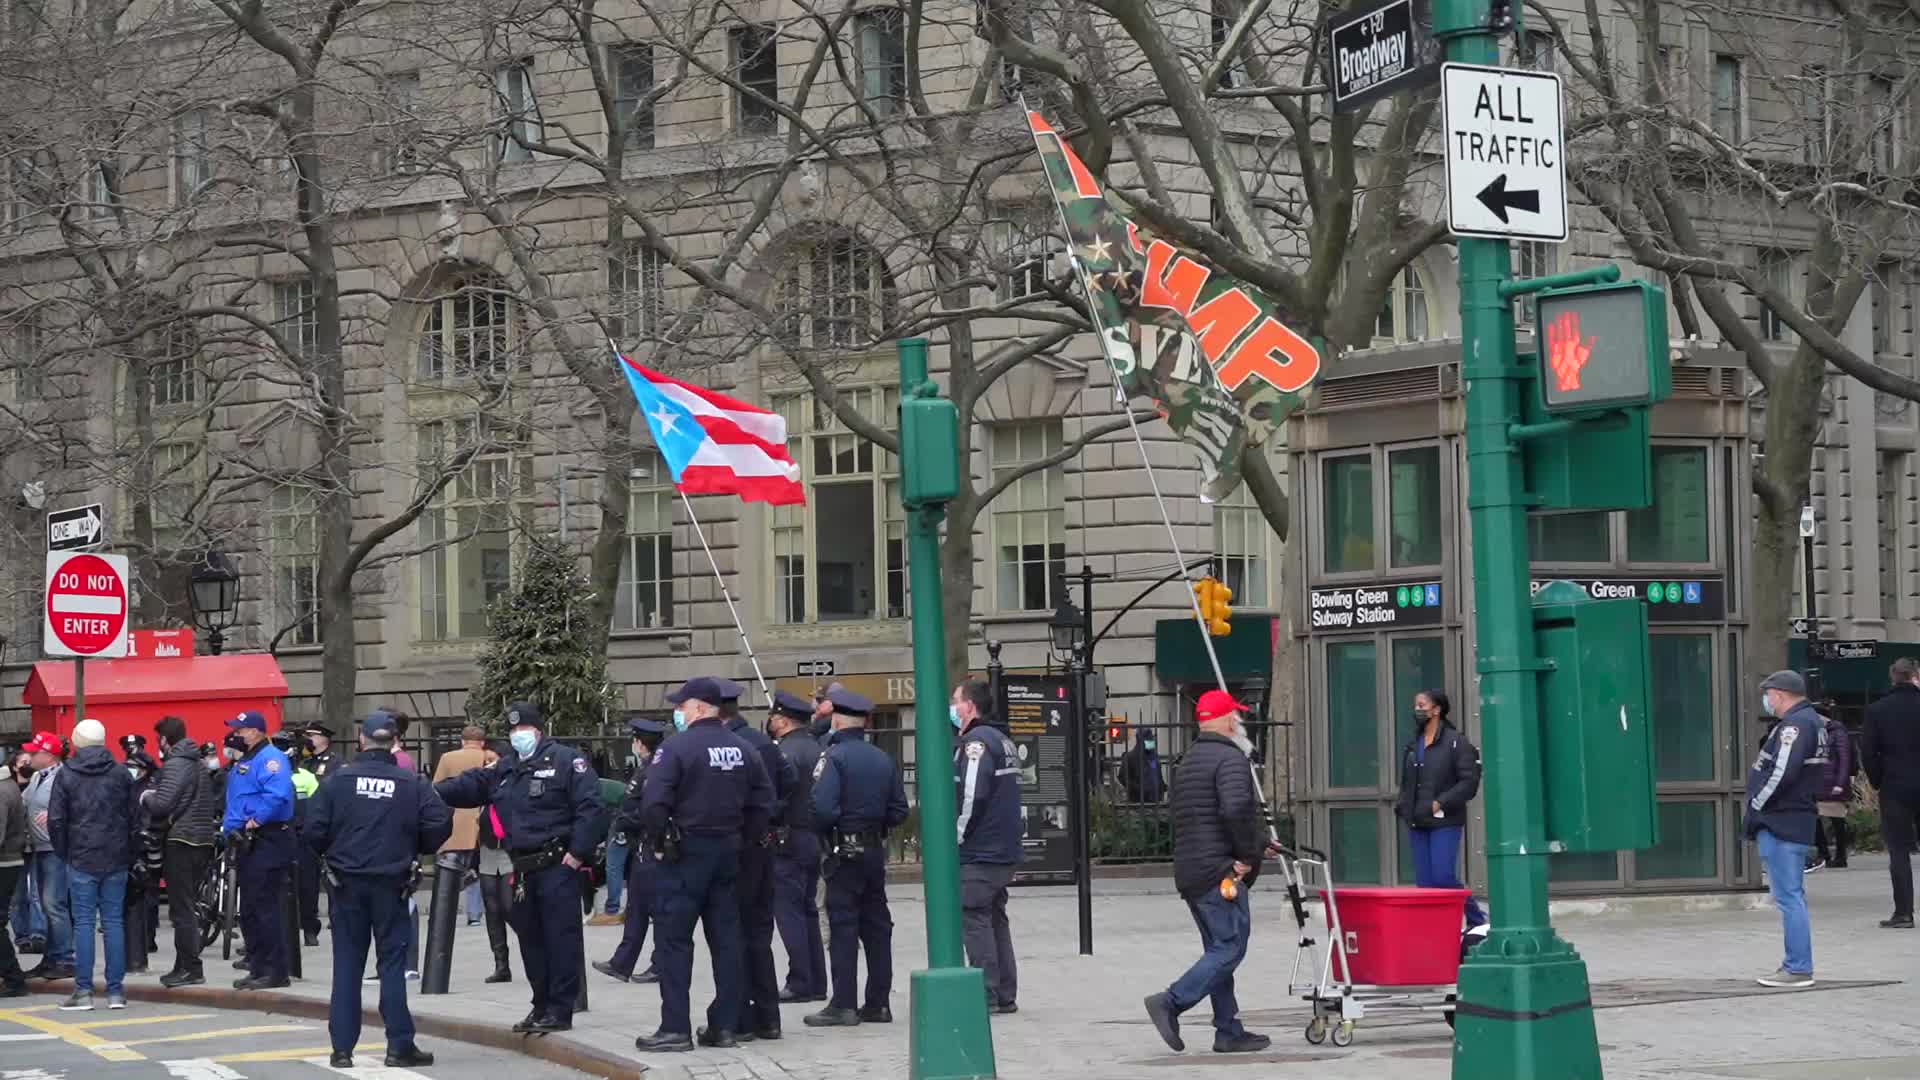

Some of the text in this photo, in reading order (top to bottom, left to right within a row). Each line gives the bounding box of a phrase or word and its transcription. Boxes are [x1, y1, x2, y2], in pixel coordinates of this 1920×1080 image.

[1340, 31, 1406, 84] Broadway
[1474, 83, 1534, 124] ALL
[1455, 131, 1554, 168] TRAFFIC
[53, 519, 95, 540] ONE WAY
[59, 573, 115, 591] DO NOT
[1591, 581, 1636, 598] Green
[1311, 591, 1353, 609] Bowling
[1355, 588, 1389, 605] Green
[63, 618, 109, 635] ENTER
[1312, 606, 1395, 627] Subway Station
[887, 678, 915, 700] HS
[708, 746, 743, 762] NYPD
[356, 776, 396, 793] NYPD
